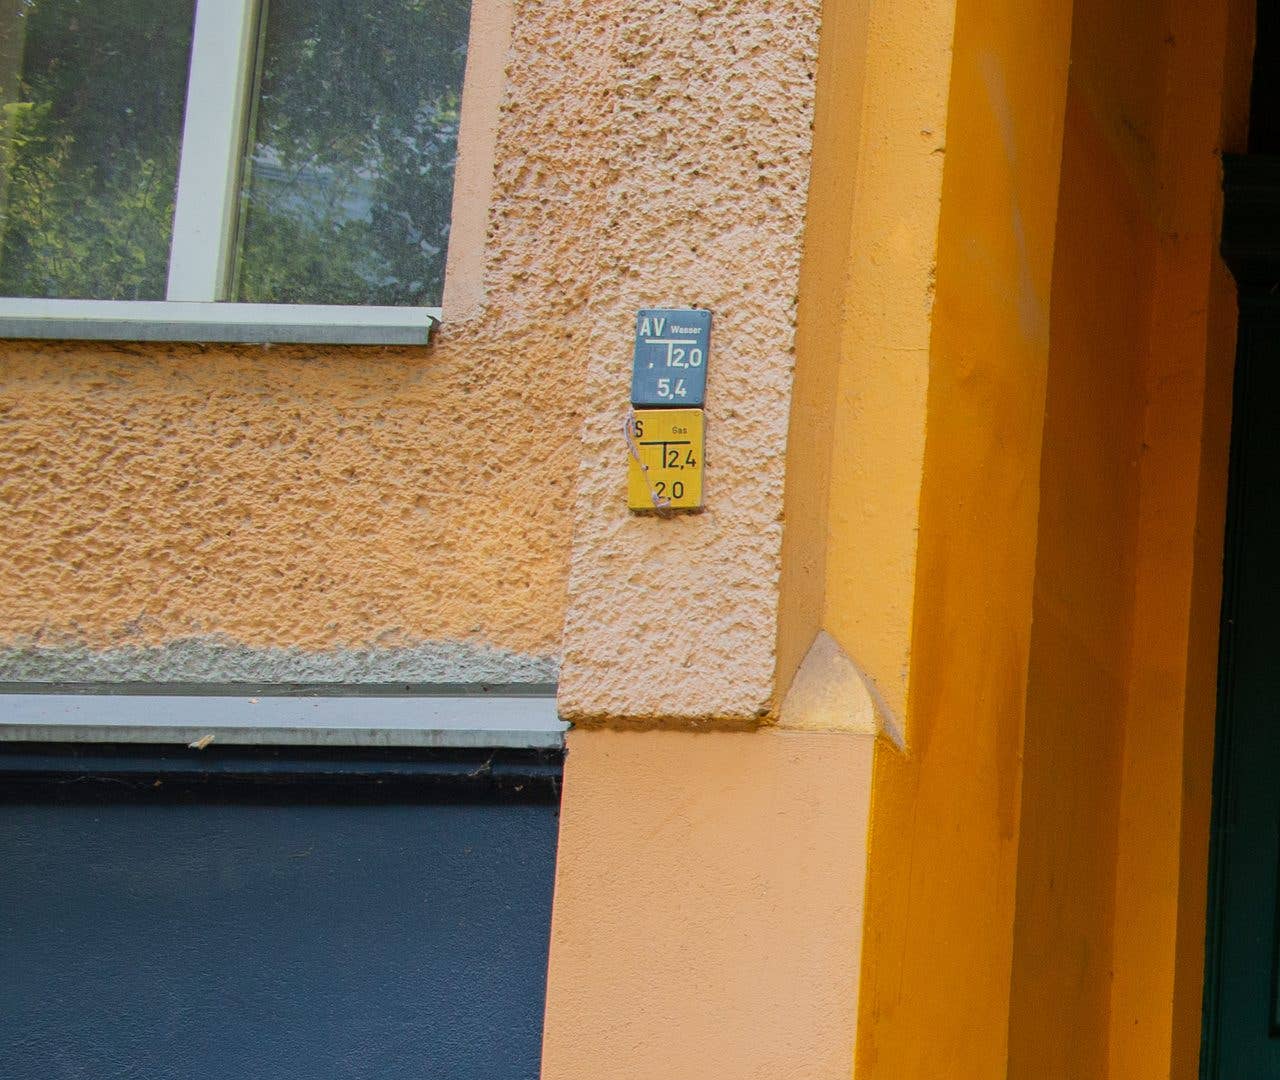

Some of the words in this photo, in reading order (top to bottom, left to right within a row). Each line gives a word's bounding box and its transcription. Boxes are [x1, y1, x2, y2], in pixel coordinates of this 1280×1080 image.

[670, 325, 703, 334] Wasser
[656, 378, 688, 400] 5,4
[671, 426, 688, 435] Gas
[655, 481, 684, 501] 2,0
